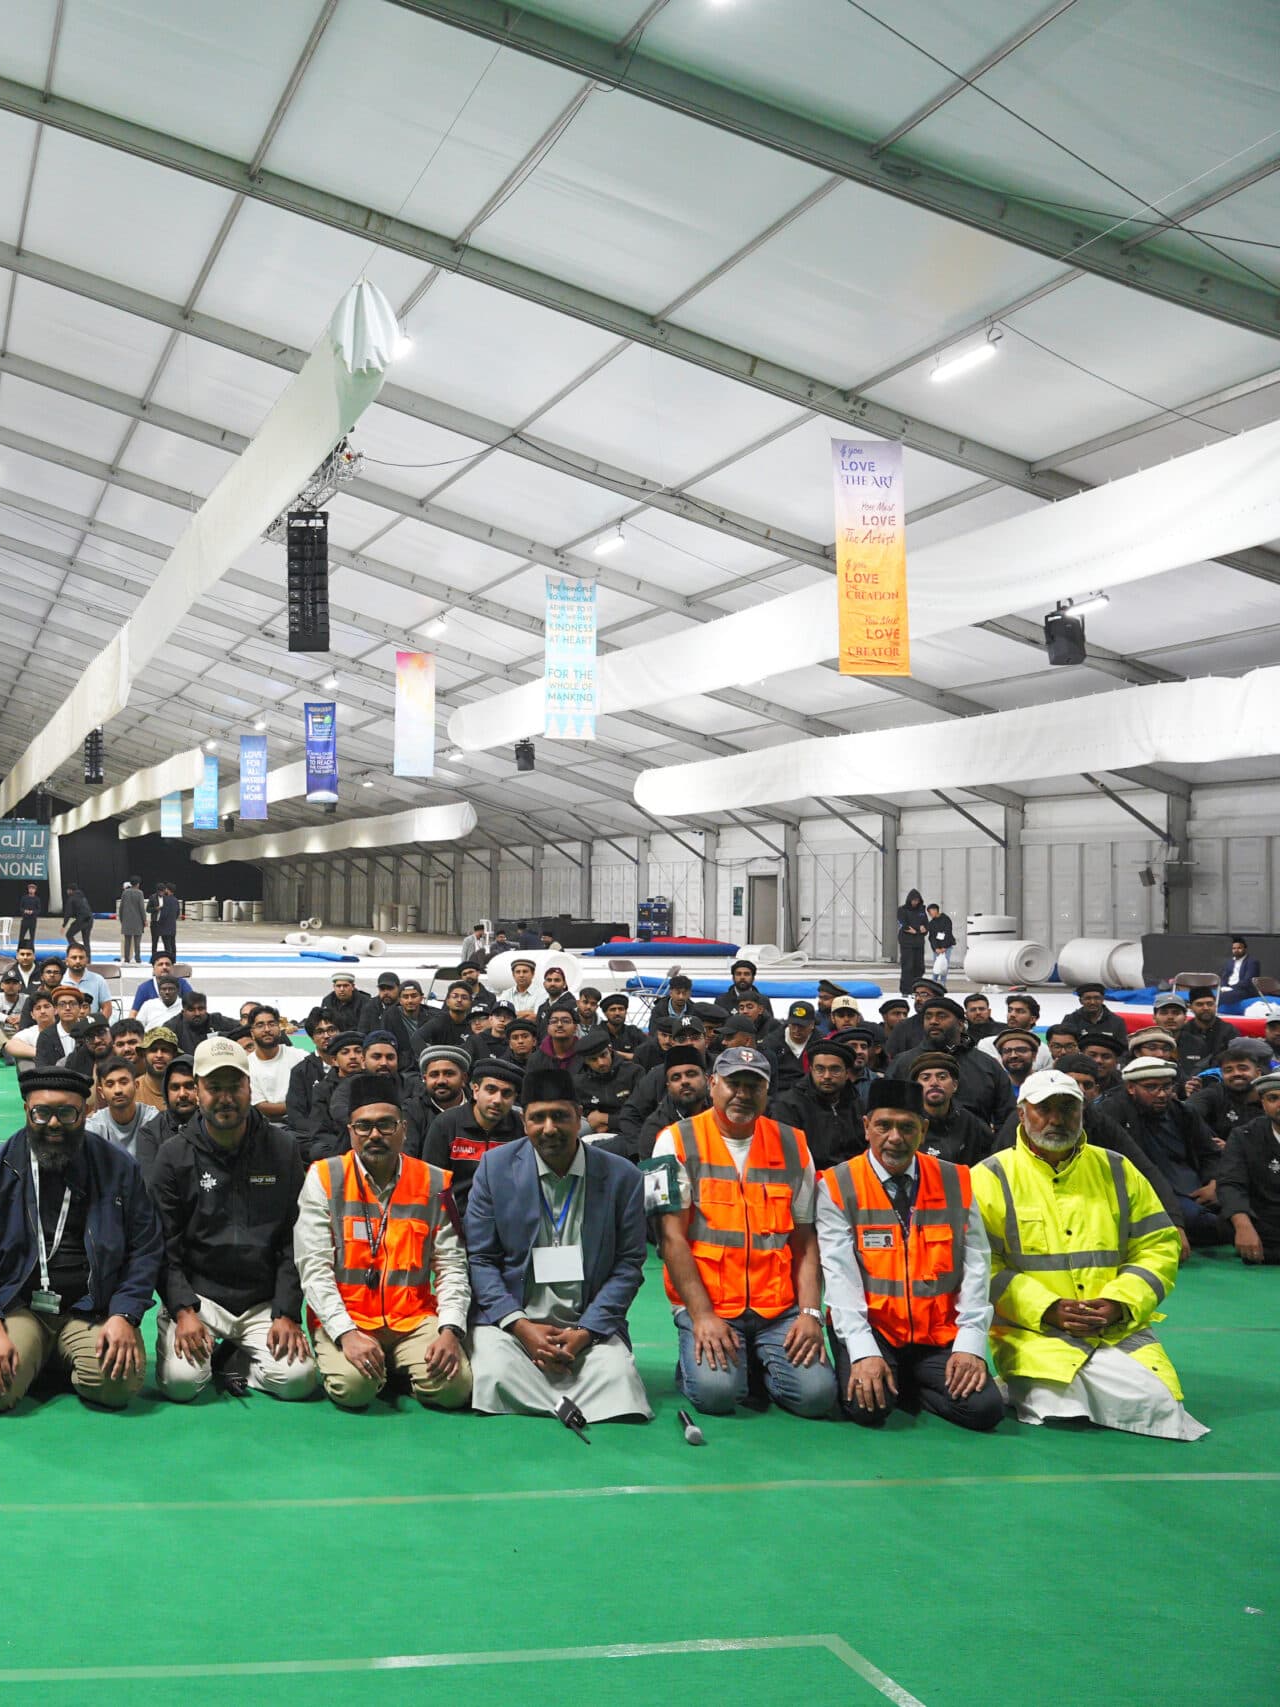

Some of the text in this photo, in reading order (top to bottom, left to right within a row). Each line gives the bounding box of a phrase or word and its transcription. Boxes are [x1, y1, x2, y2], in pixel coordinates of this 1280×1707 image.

[841, 461, 876, 472] LOVE
[843, 474, 893, 489] THE ART
[862, 515, 896, 526] LOVE
[861, 529, 896, 544] Artist
[845, 572, 879, 584] LOVE
[846, 591, 899, 600] CREATION
[550, 624, 592, 632] KINDNESS
[866, 629, 900, 640] LOVE
[563, 637, 592, 645] HEART
[848, 647, 899, 656] CREATOR
[548, 669, 592, 679] FOR THE
[550, 682, 579, 690] WHOLE
[548, 693, 592, 701] MANKIND
[1, 830, 26, 852] إله
[31, 831, 44, 848] لا
